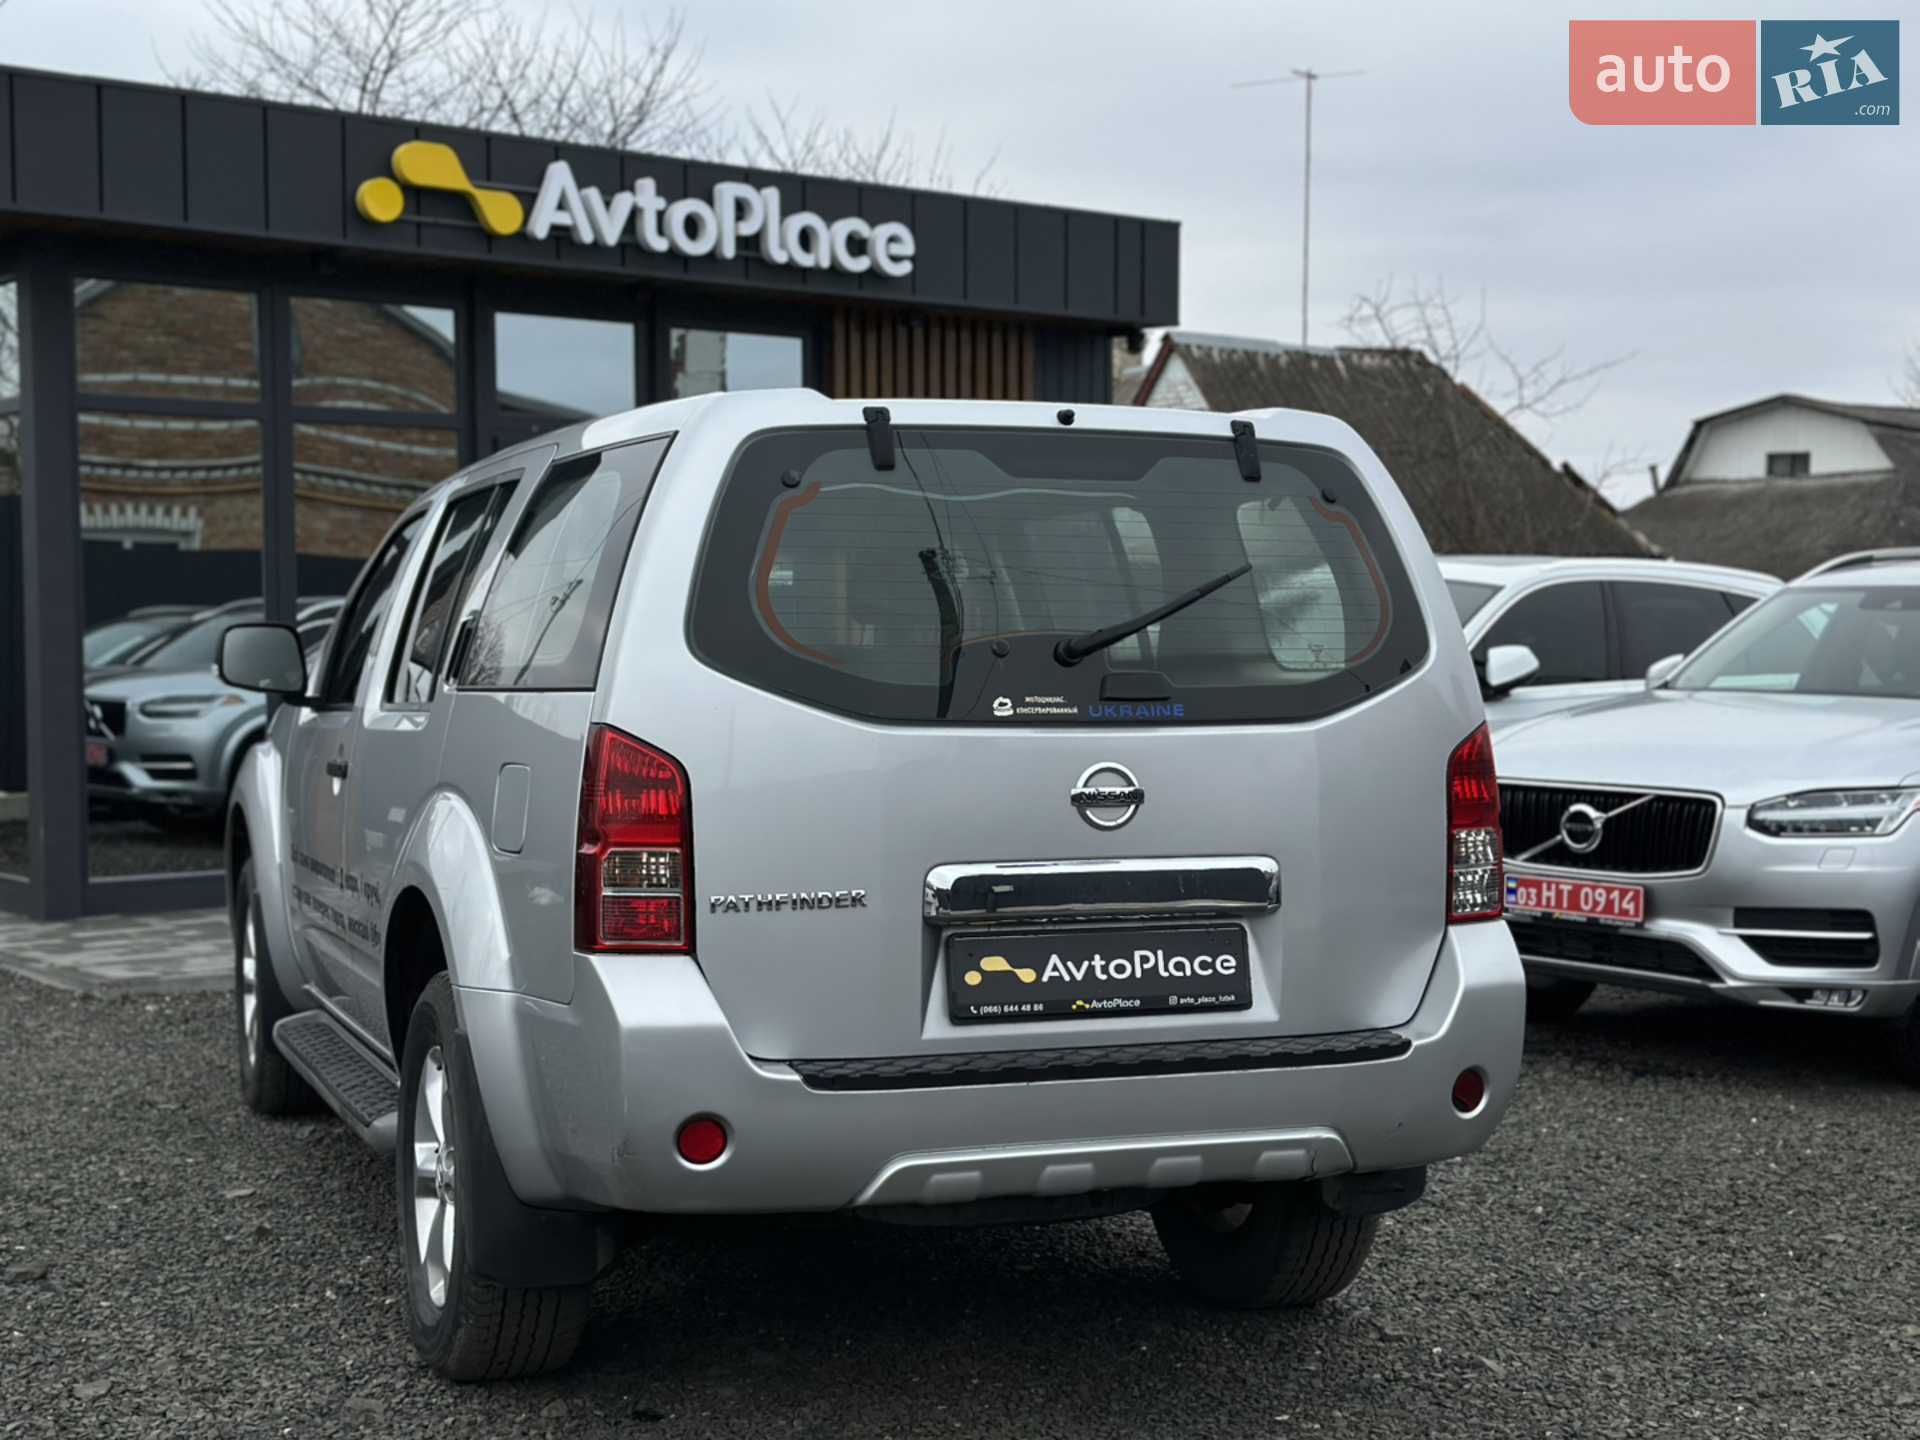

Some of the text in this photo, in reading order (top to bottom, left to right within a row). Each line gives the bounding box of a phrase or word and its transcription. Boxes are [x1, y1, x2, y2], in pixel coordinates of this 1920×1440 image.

[526, 159, 915, 277] AvtoPlace
[1089, 703, 1185, 718] UKRAINE
[1081, 791, 1138, 804] NISSAN
[710, 889, 867, 913] PATHFINDER
[1517, 881, 1635, 916] 03 HT 0914
[1041, 950, 1237, 983] AvtoPlace
[1090, 999, 1140, 1008] AvtoPlace
